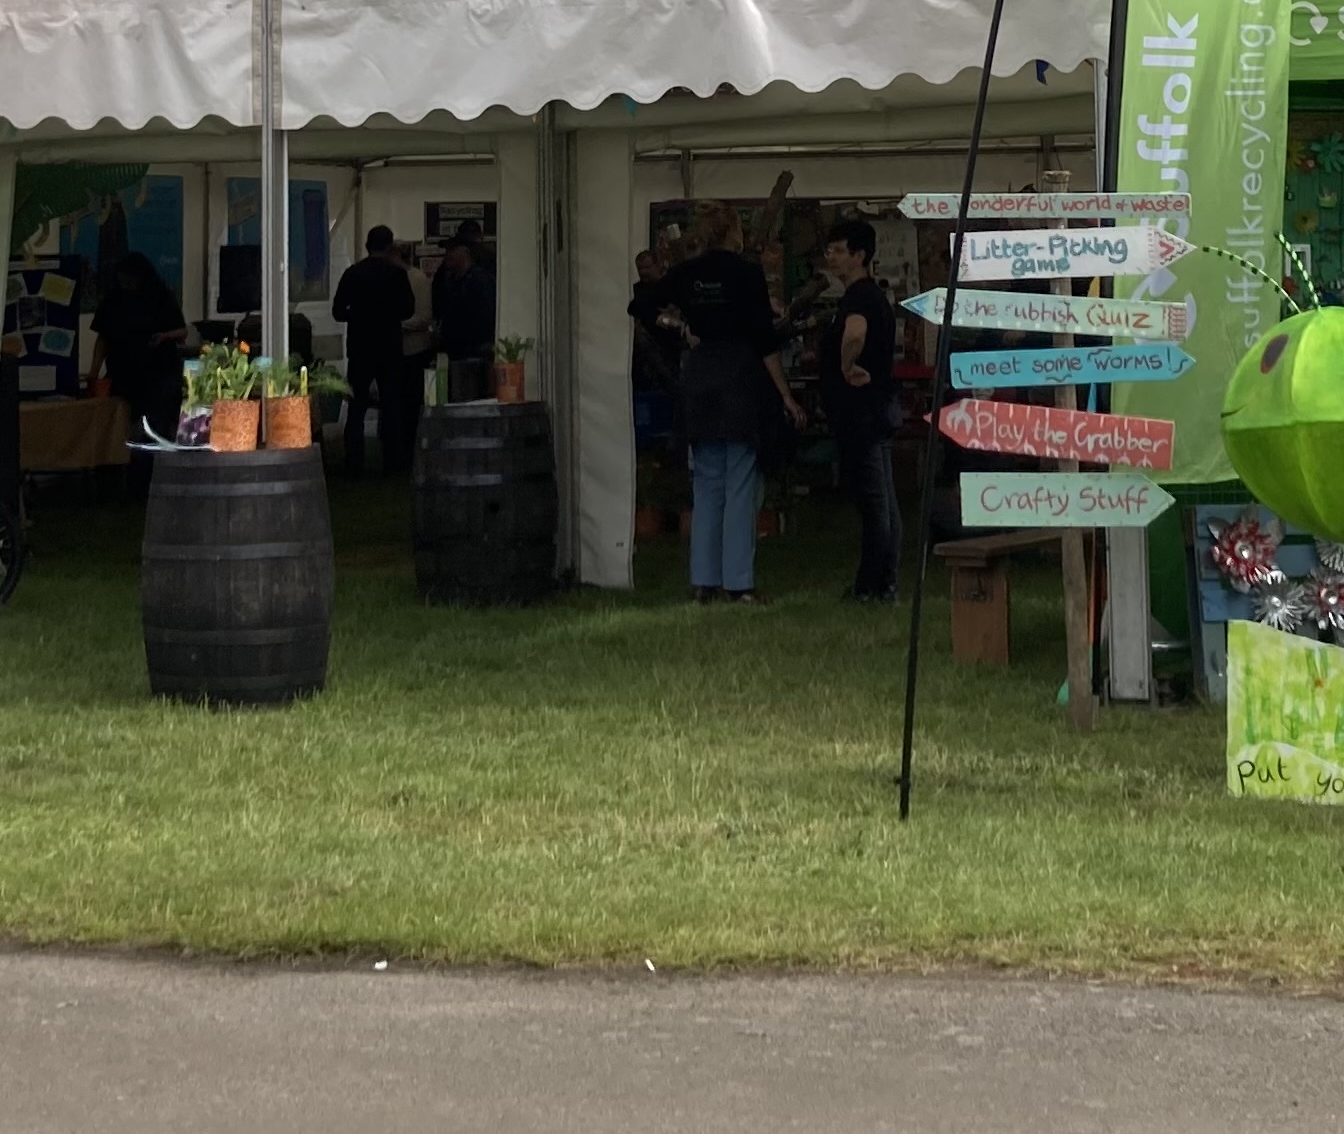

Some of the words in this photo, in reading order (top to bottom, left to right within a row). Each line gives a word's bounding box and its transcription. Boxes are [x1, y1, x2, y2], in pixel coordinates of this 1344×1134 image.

[911, 196, 949, 215] the
[957, 195, 1053, 214] onderful
[1062, 195, 1112, 212] world
[970, 234, 1128, 264] Litter-Picking
[1011, 256, 1071, 277] game
[964, 298, 999, 317] the
[970, 356, 1022, 378] meet
[1032, 354, 1083, 374] some
[975, 412, 1025, 446] Play
[1034, 419, 1067, 445] the
[1074, 421, 1169, 453] Grabber
[980, 485, 1070, 516] Crafty
[1079, 485, 1151, 515] Stuff
